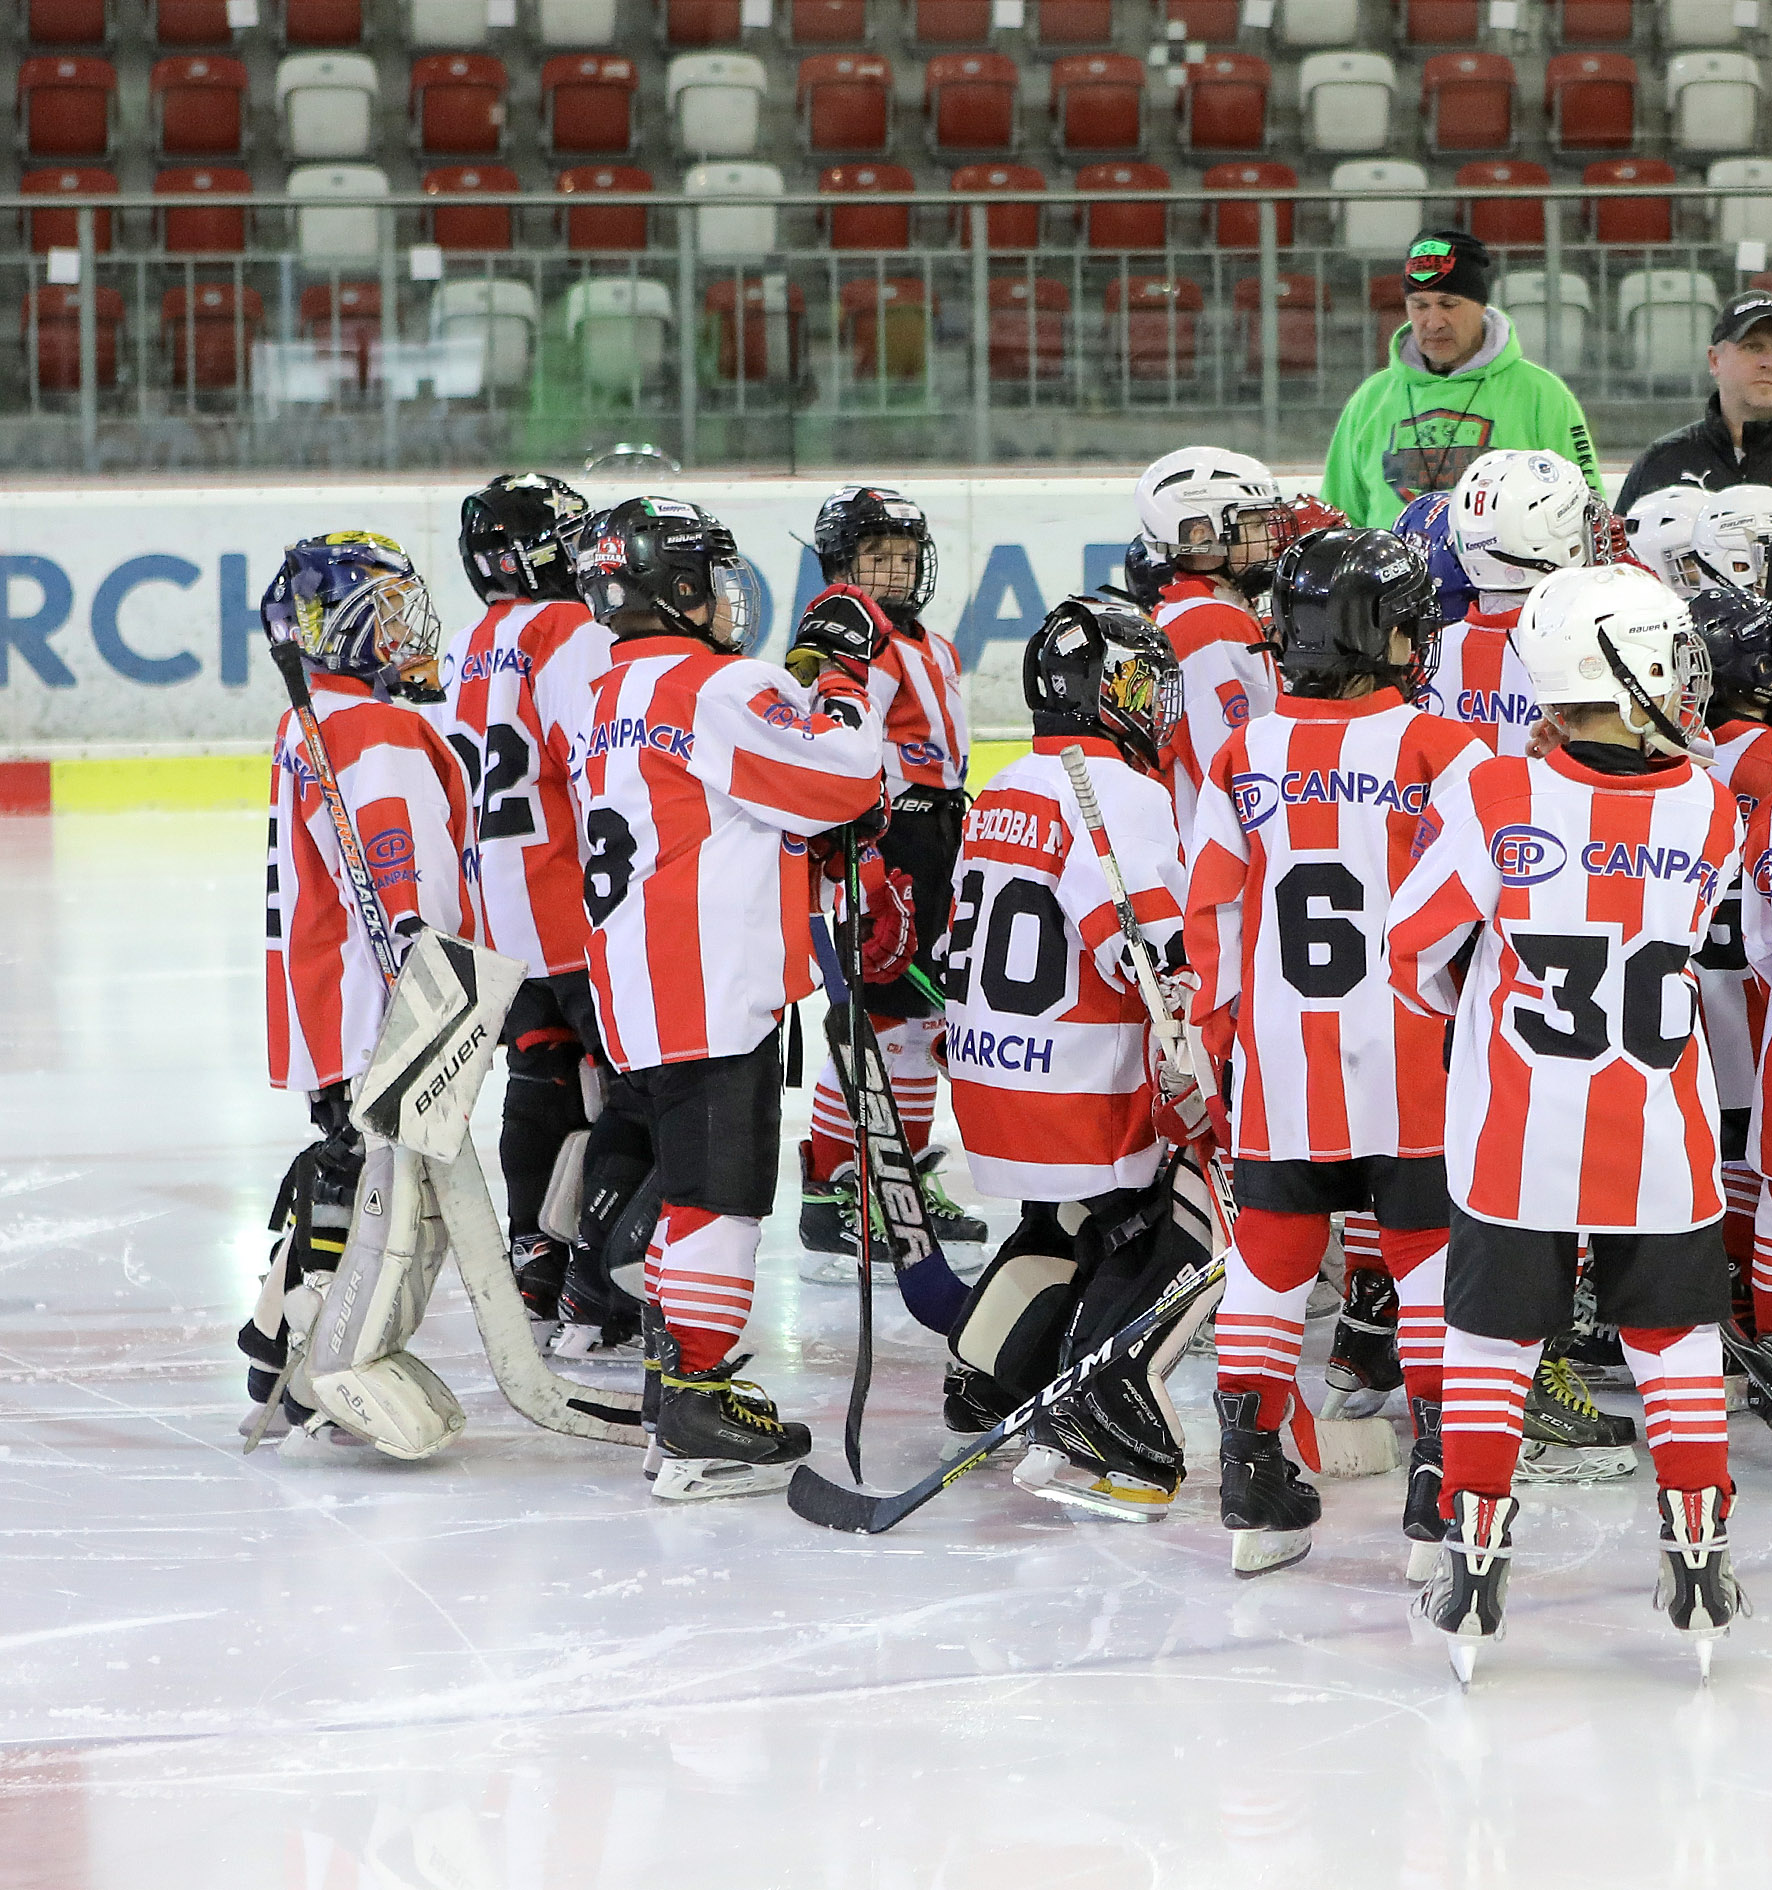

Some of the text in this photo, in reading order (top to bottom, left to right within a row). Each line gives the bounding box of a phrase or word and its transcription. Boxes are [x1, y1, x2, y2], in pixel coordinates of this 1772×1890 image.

[1474, 491, 1487, 516] 8
[1275, 862, 1368, 998] 6
[945, 1020, 1053, 1073] MARCH
[1512, 934, 1697, 1071] 30
[415, 1022, 489, 1116] BAUER
[1003, 1336, 1115, 1436] CCM
